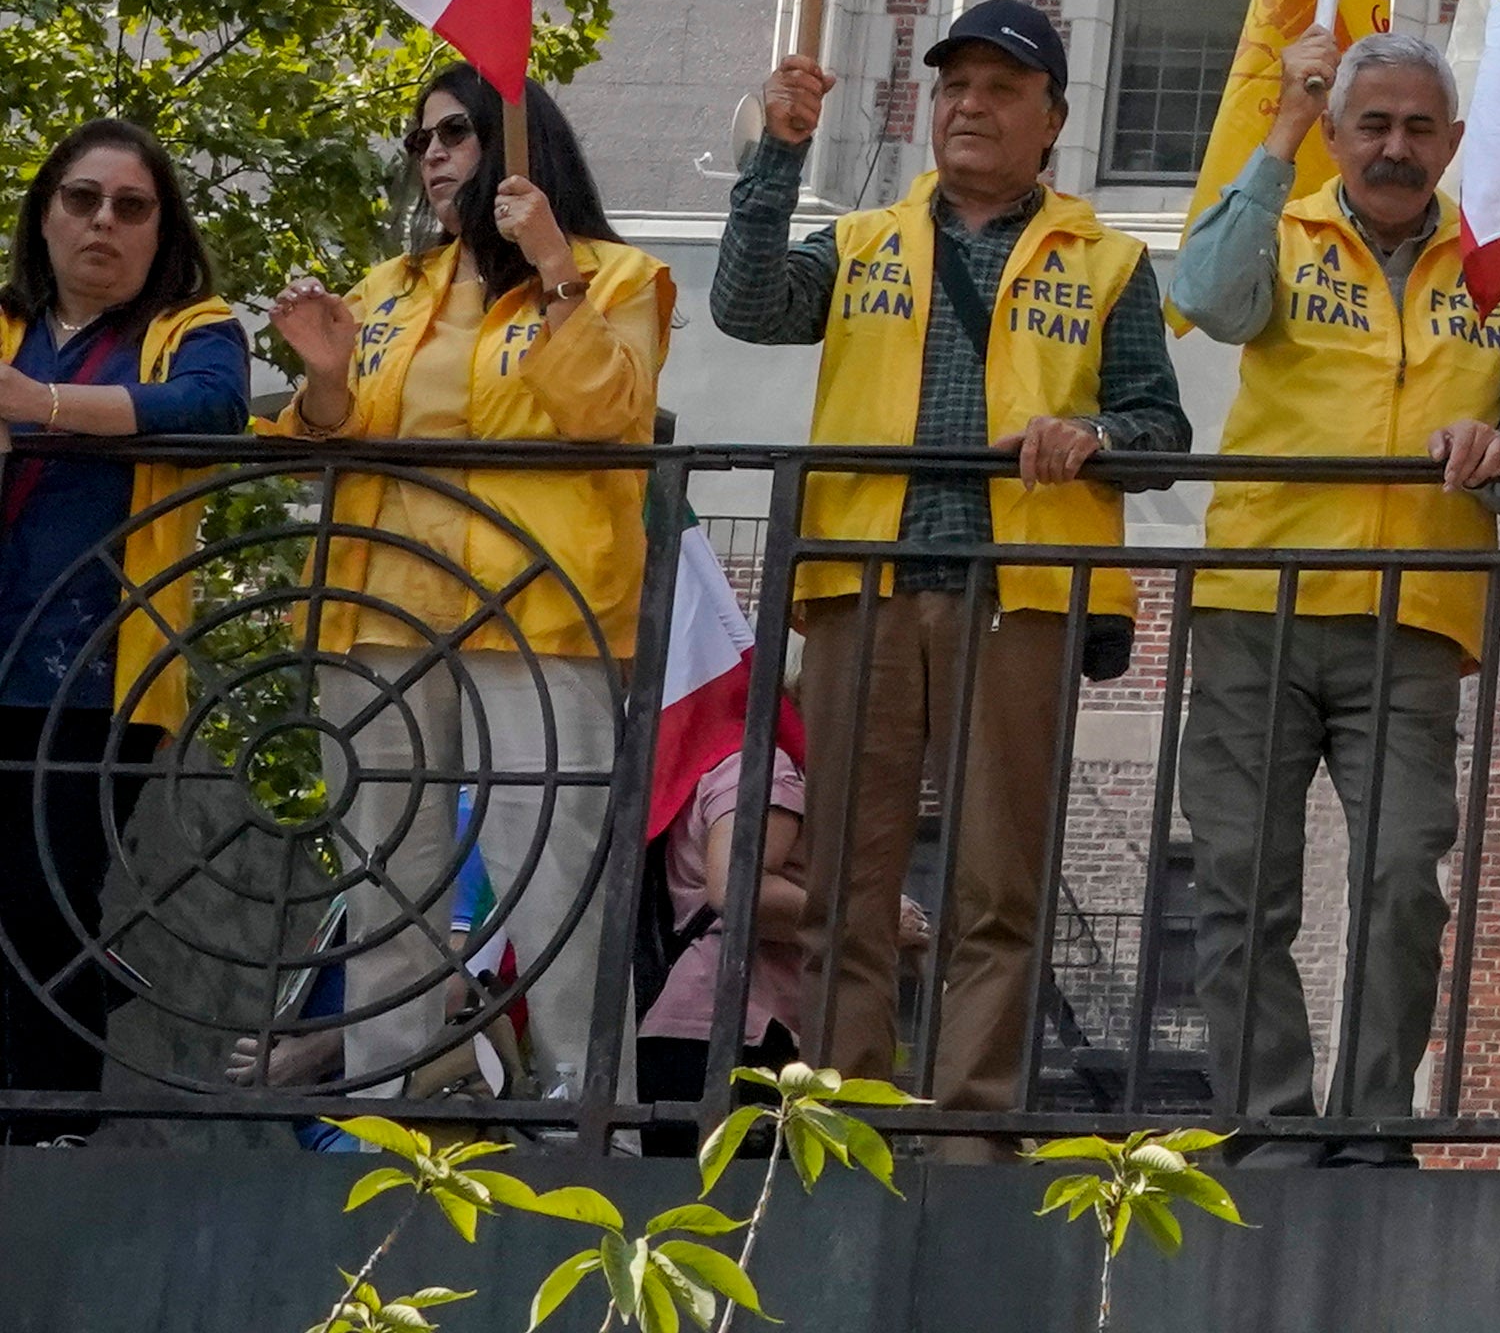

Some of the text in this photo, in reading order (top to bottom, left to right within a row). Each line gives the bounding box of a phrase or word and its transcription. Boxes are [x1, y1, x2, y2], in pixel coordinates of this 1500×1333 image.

[879, 233, 900, 257] A
[1043, 249, 1066, 274] A
[1321, 244, 1341, 272] A
[1011, 277, 1094, 311] FREE
[1295, 263, 1369, 310] FREE
[1009, 307, 1091, 347] IRAN
[1290, 292, 1371, 333] IRAN
